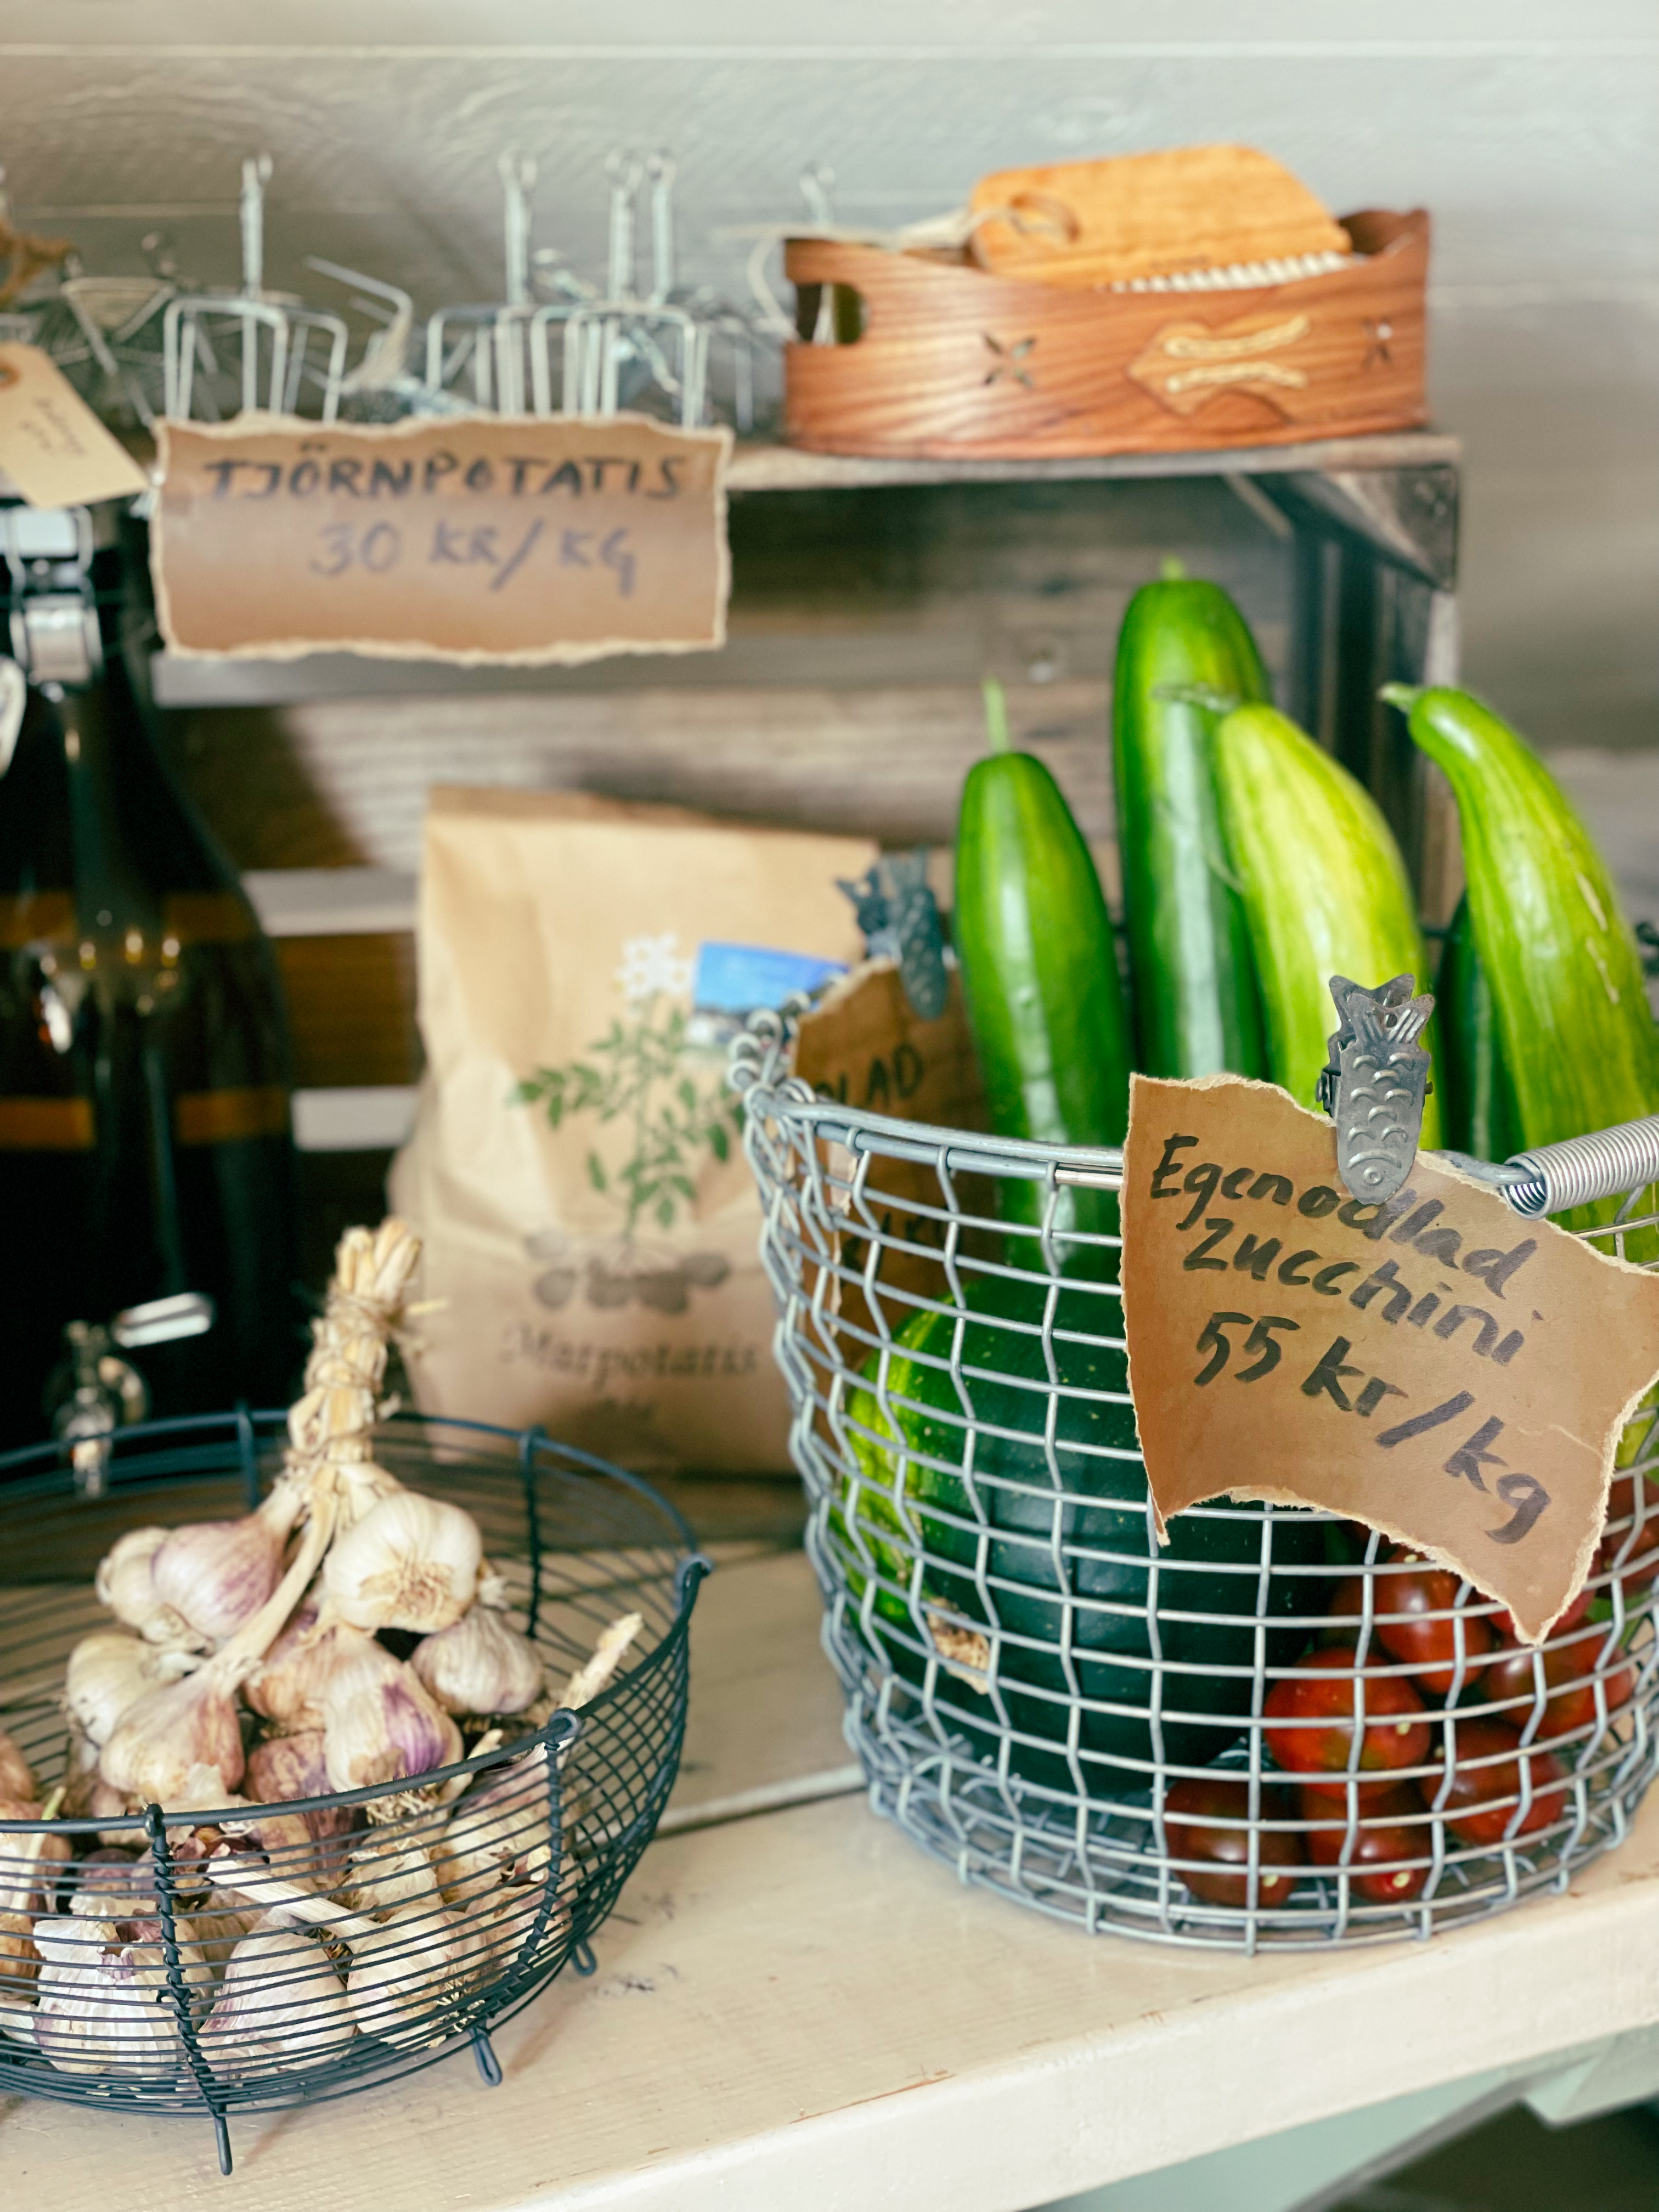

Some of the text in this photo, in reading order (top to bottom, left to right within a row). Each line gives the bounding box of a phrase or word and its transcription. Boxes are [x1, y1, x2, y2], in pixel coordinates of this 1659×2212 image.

[203, 441, 688, 500] TJÖRNPOTATIS
[308, 520, 402, 578] 30
[1150, 1132, 1538, 1299] Egenodlad
[1193, 1311, 1553, 1544] 55 kr/kg
